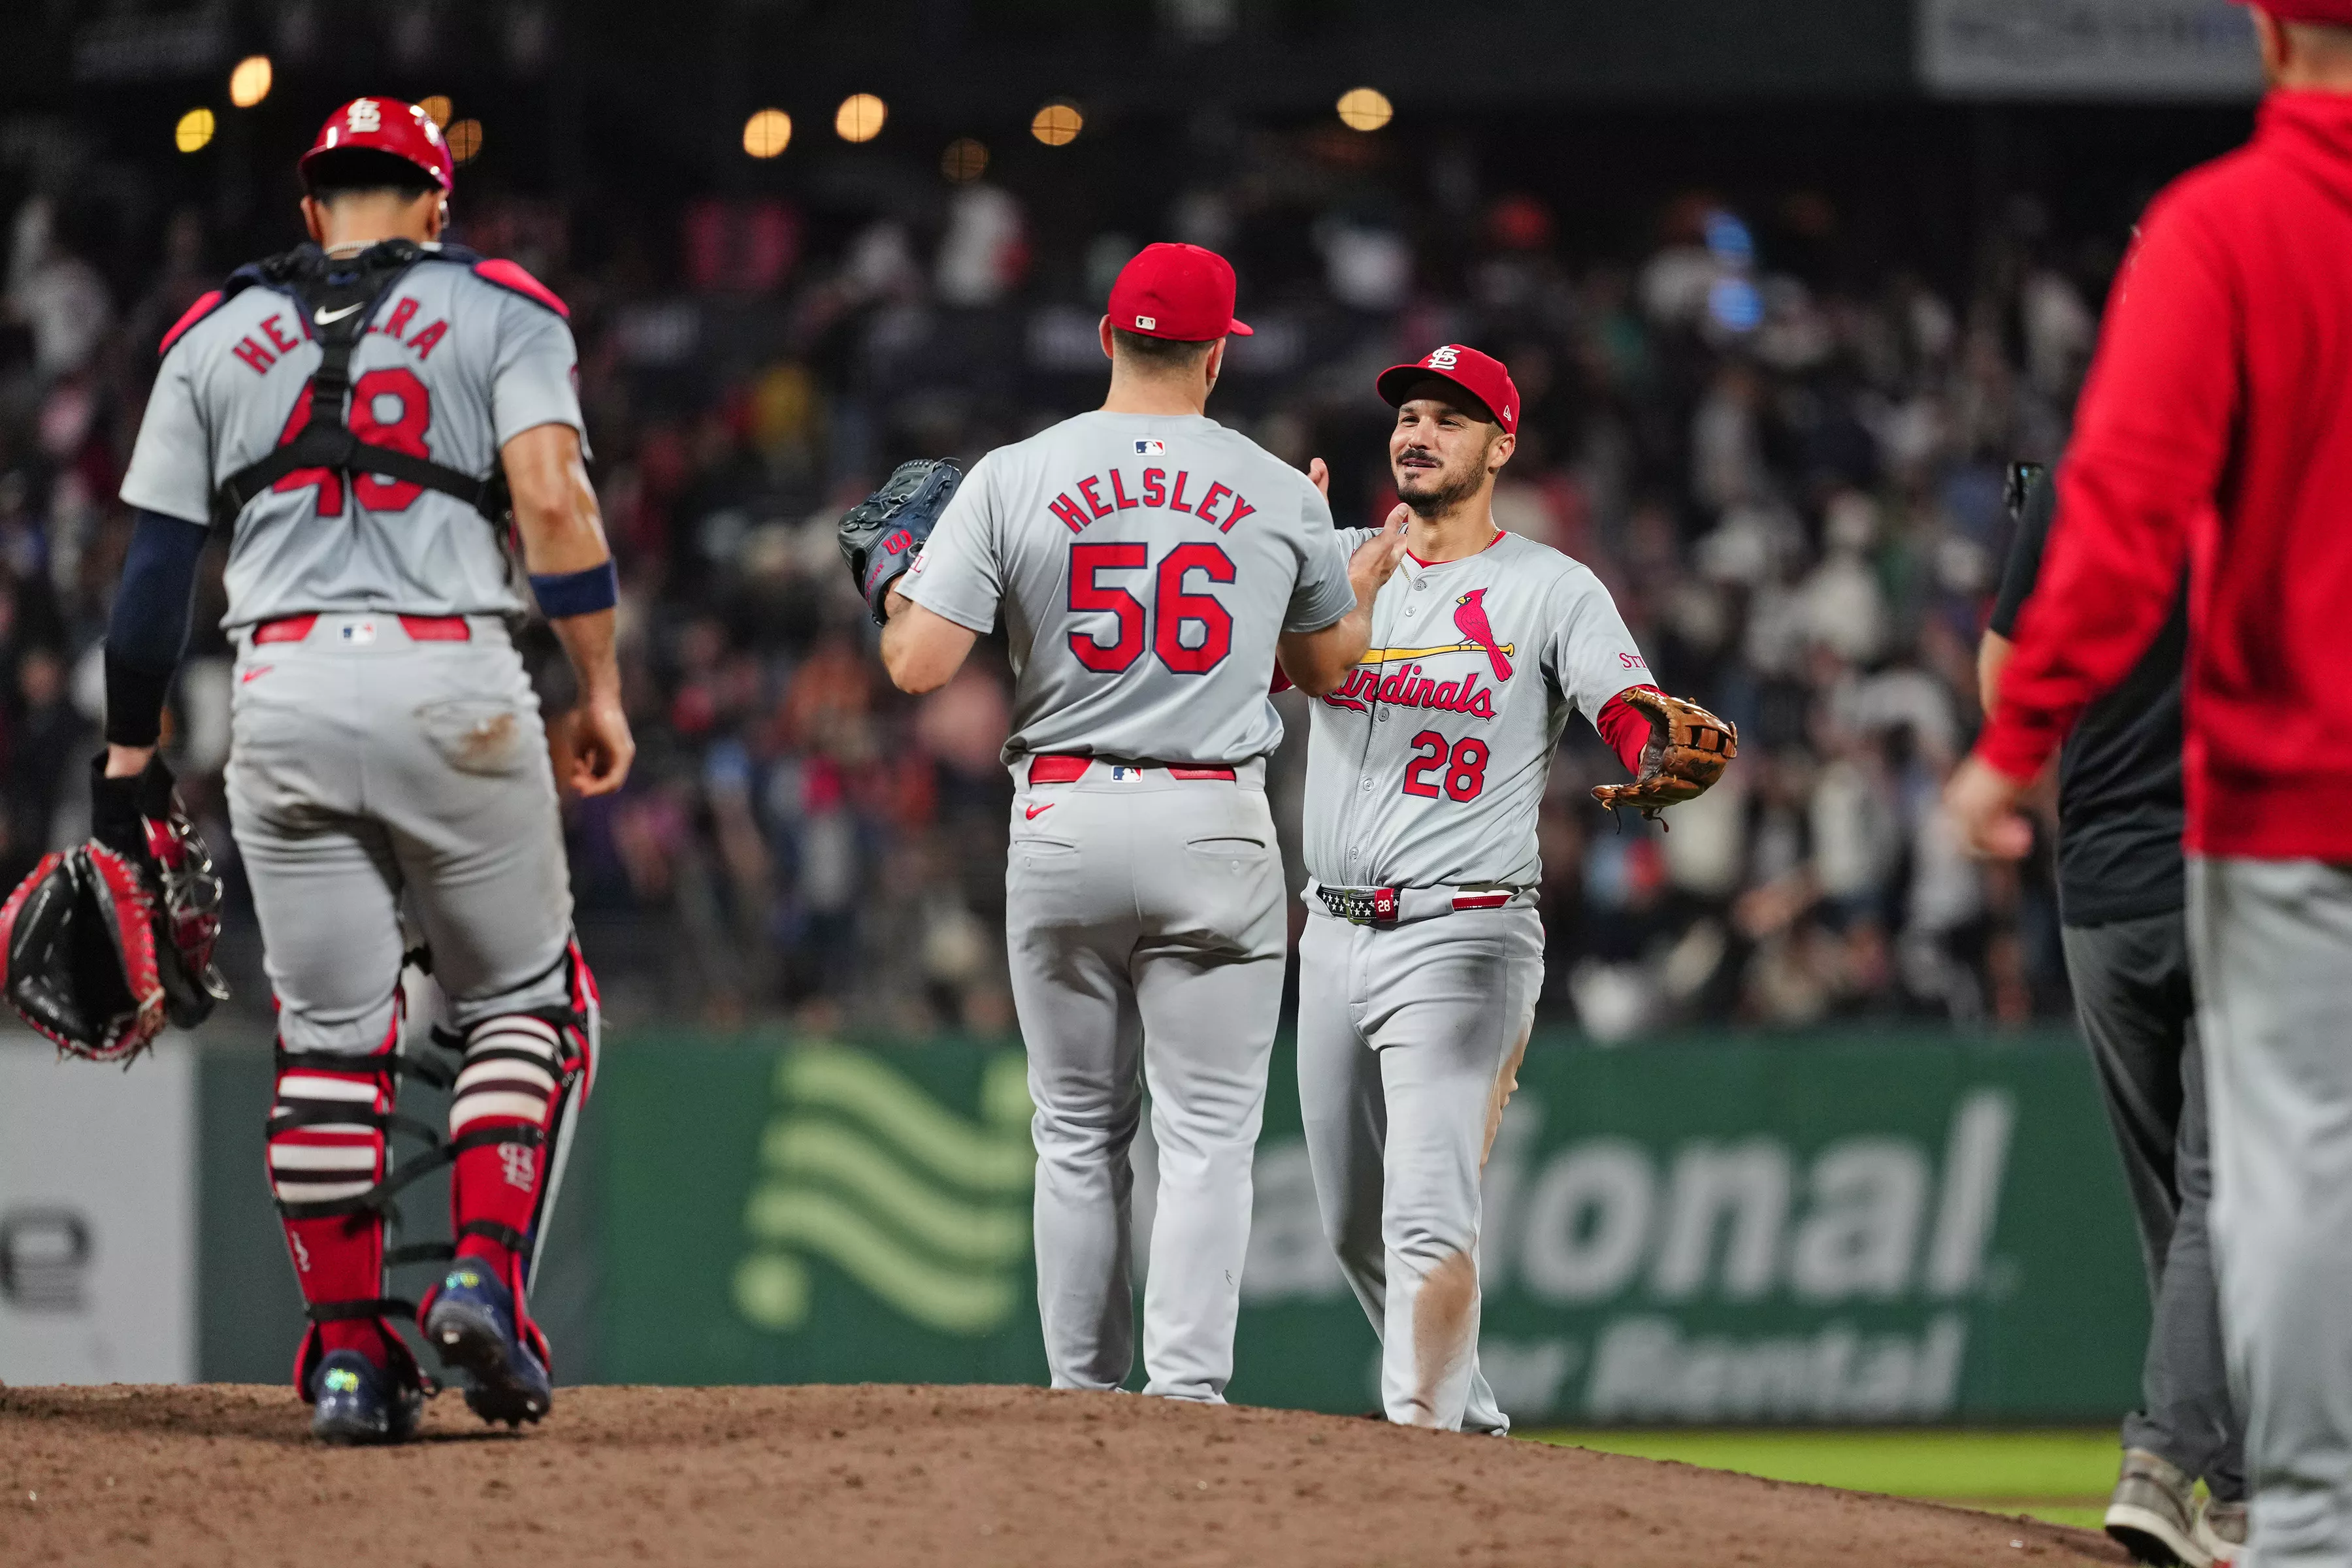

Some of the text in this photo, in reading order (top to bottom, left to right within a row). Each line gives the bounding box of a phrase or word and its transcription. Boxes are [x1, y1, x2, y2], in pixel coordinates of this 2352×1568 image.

[231, 296, 449, 376] HERA
[1047, 468, 1257, 535] HELSLEY
[1068, 542, 1237, 676] 56
[1402, 730, 1490, 803] 28
[1377, 899, 1391, 912] 28
